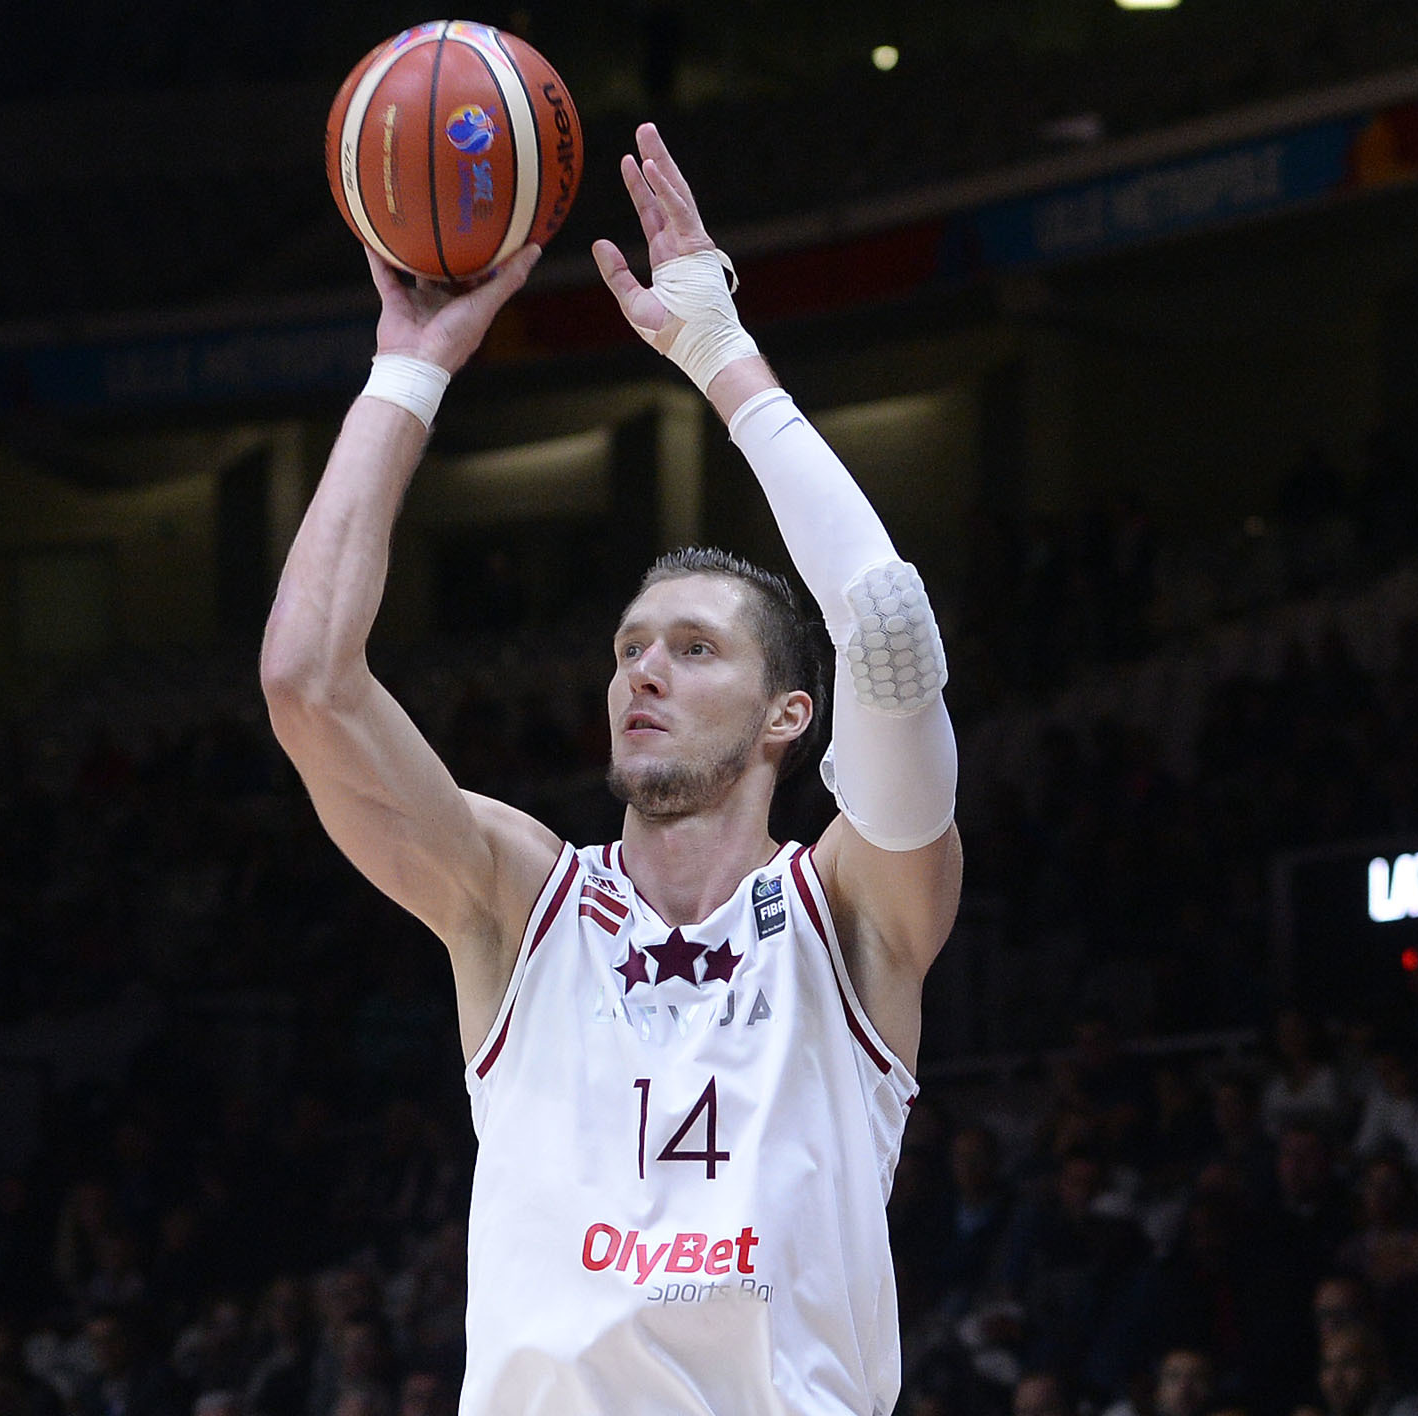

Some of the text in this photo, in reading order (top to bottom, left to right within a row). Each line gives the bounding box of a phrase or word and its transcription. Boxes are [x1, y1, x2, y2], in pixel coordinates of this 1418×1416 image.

[760, 899, 786, 921] FIBA
[633, 1074, 731, 1180] 14
[582, 1222, 760, 1286] OlyBet
